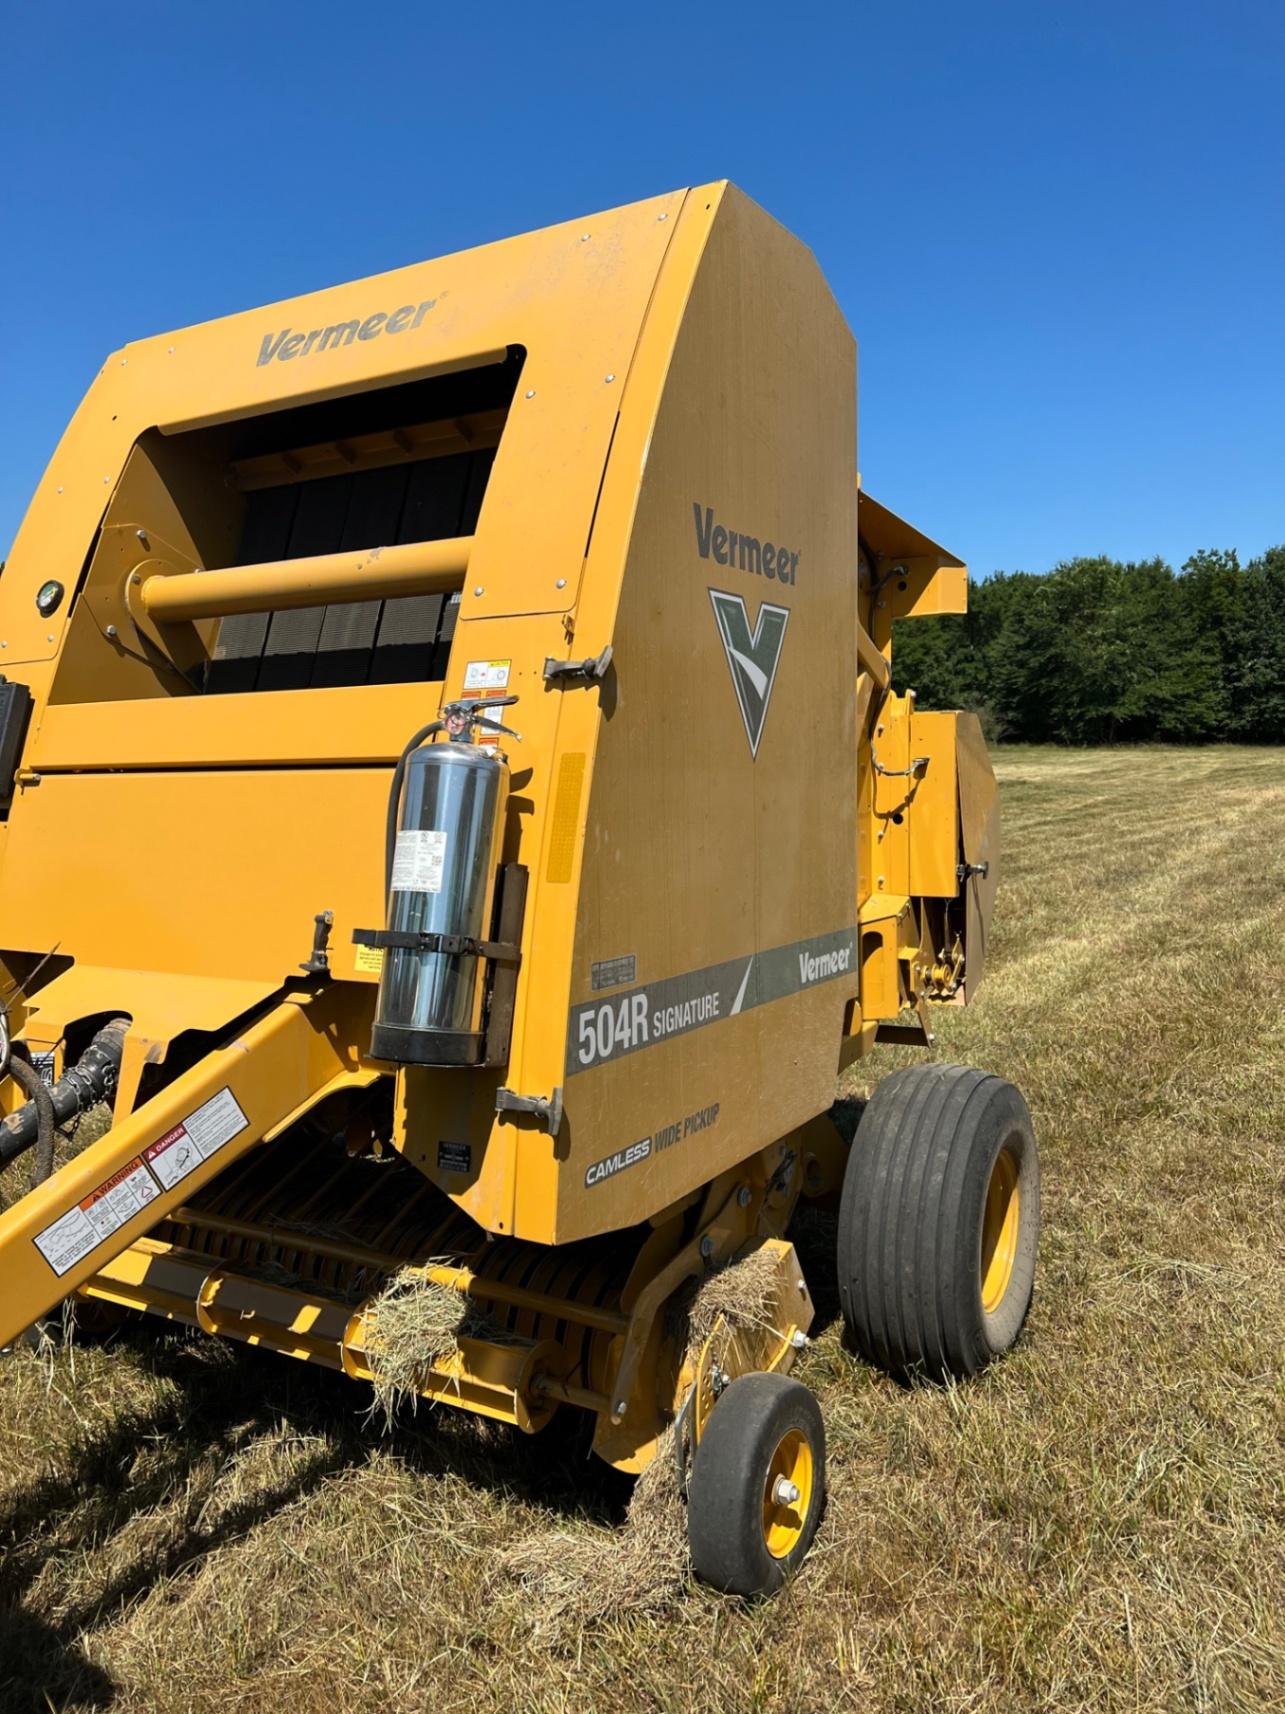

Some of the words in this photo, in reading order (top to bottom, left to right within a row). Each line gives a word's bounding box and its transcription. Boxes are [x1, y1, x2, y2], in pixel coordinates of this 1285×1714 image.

[256, 299, 437, 367] Vermeer
[693, 502, 799, 586] Vermeer
[799, 948, 850, 984] Vermeer
[578, 993, 649, 1064] 504R
[653, 992, 720, 1037] SIGNATURE
[155, 1127, 185, 1152] DANGER
[586, 1139, 650, 1185] CAMLESS
[654, 1121, 681, 1153] WIDE
[683, 1102, 720, 1139] PICKUP
[99, 1162, 138, 1197] WARNING
